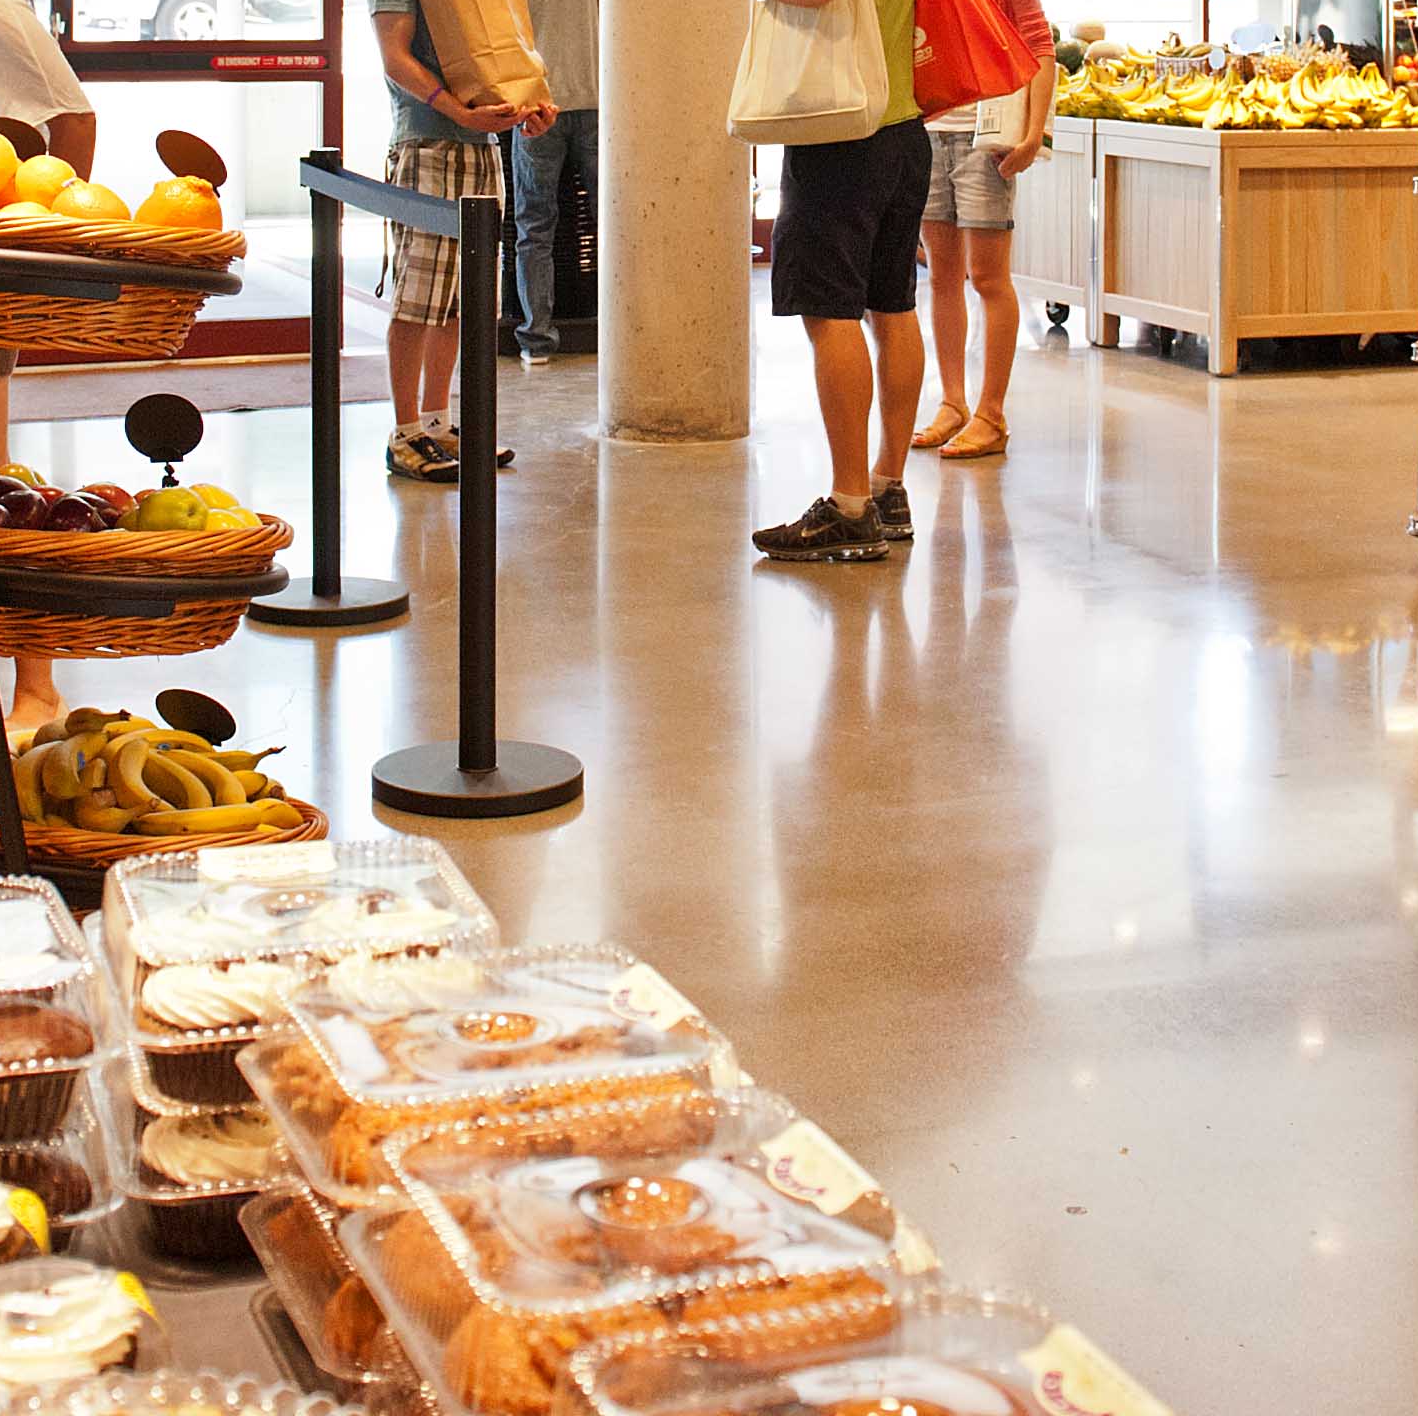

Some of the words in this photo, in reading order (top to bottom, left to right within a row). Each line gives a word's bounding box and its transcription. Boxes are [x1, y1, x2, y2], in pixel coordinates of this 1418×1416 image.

[224, 57, 261, 66] EMERGENCY
[277, 57, 294, 66] PUSH
[294, 57, 303, 66] TO
[303, 57, 319, 66] OPEN
